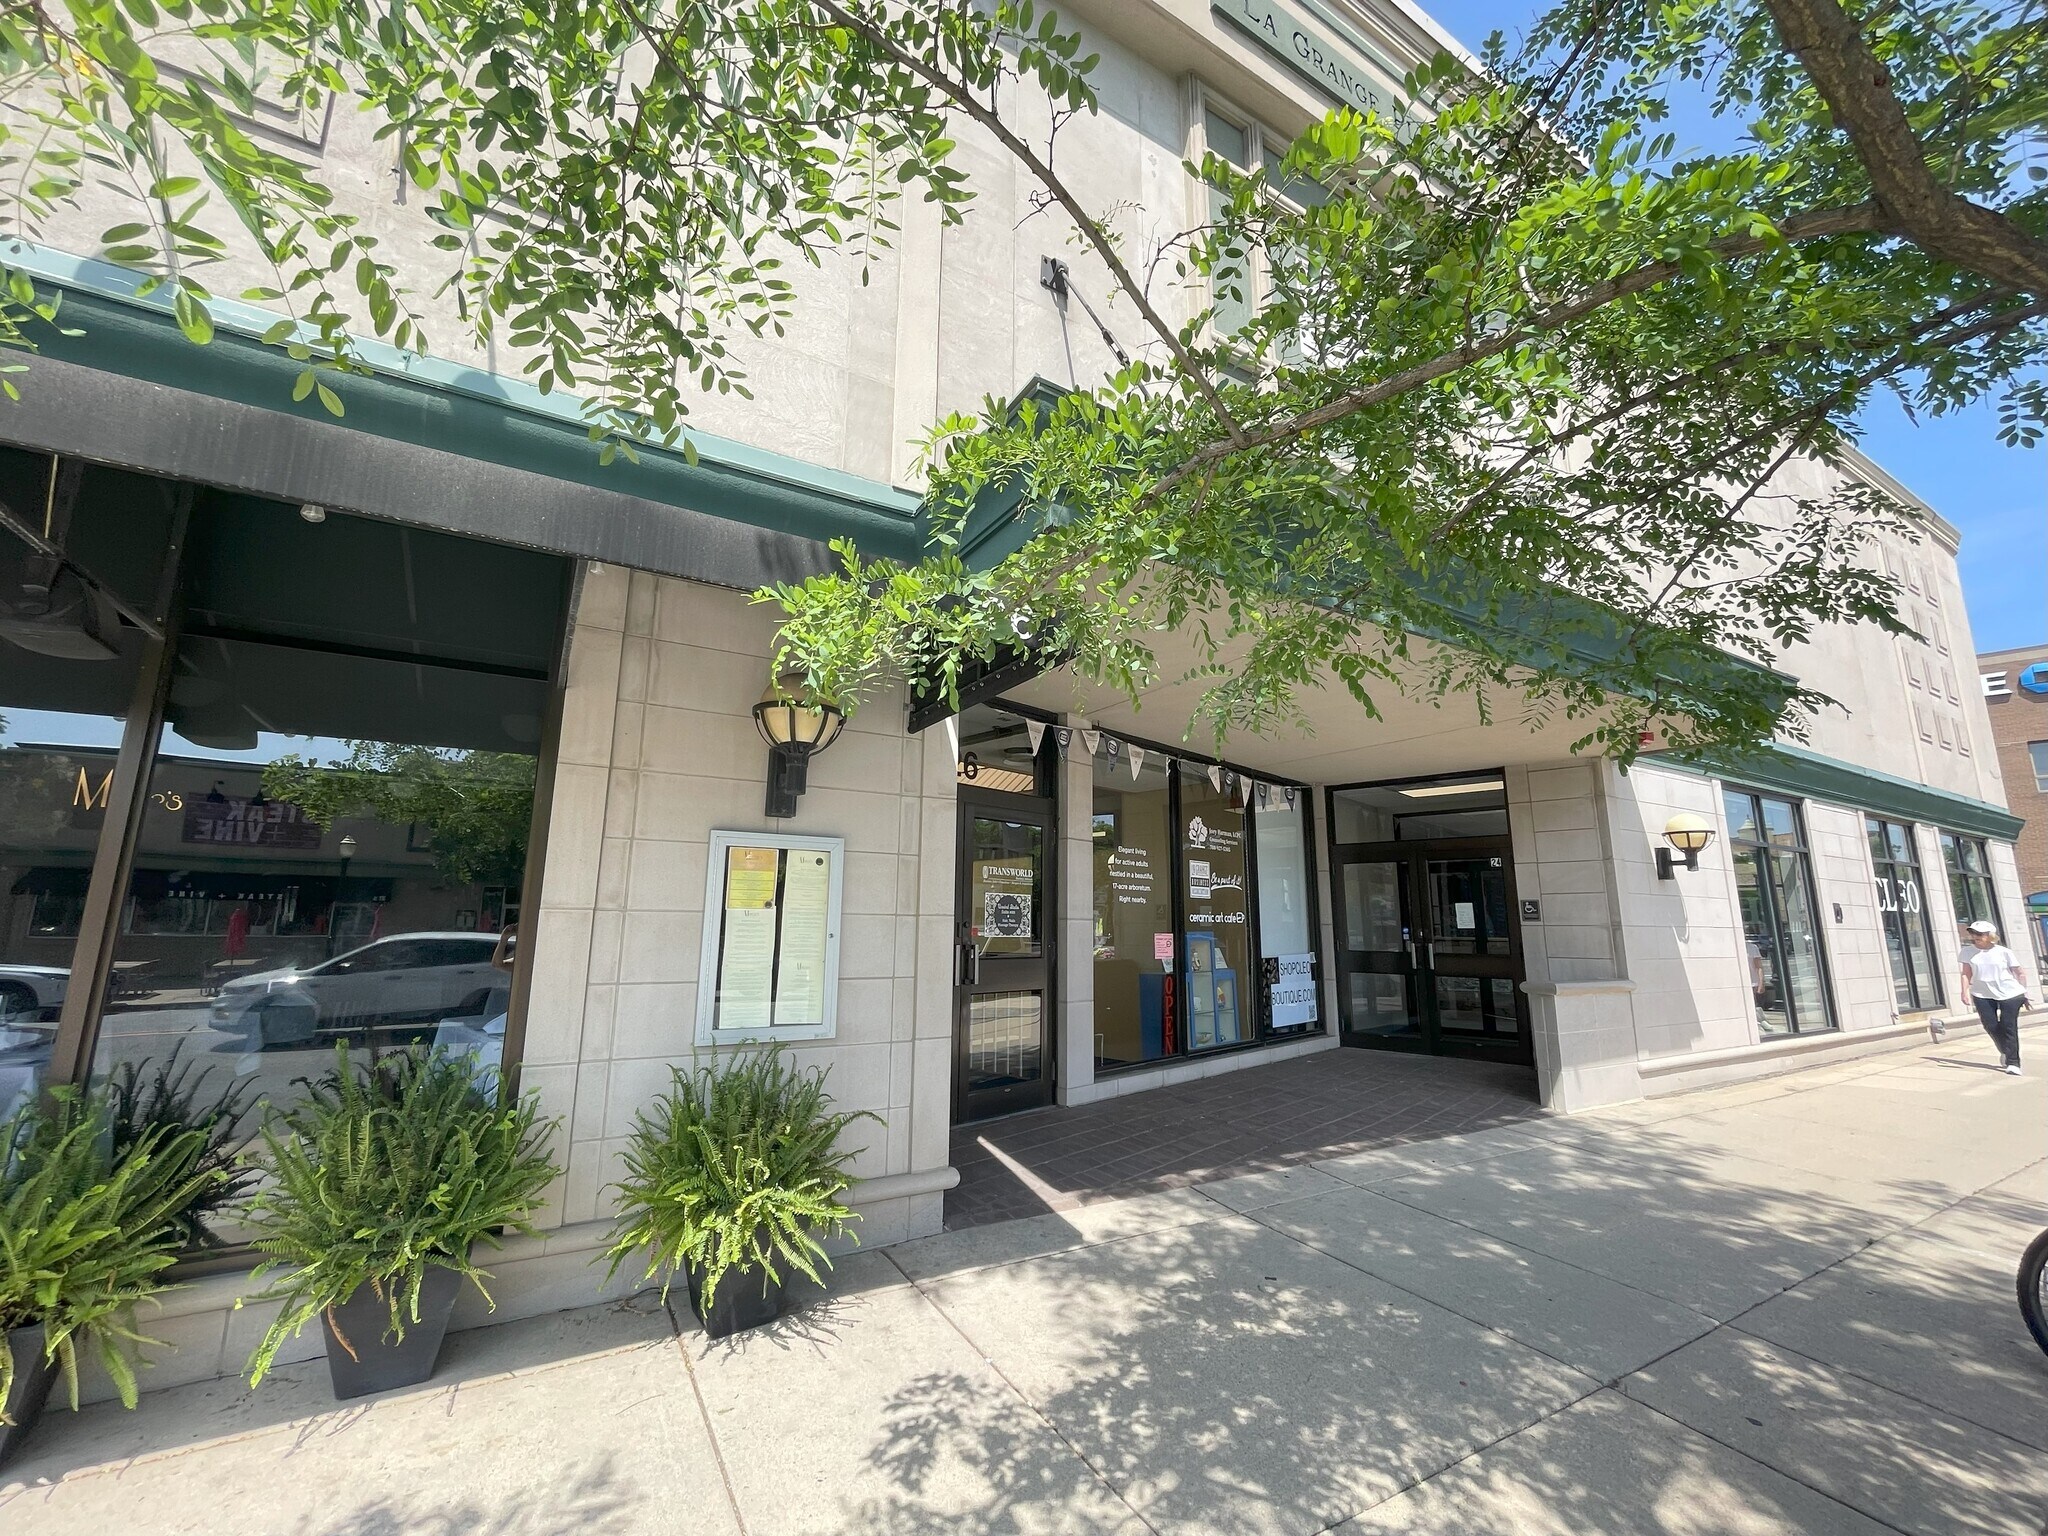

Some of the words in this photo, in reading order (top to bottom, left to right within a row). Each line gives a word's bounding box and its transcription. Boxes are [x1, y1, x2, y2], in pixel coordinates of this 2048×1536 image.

[1293, 31, 1381, 114] GRANGE
[957, 751, 978, 780] 6
[988, 865, 1034, 878] TRANSWORLD
[1189, 911, 1215, 923] ceramic
[1214, 911, 1224, 923] art
[1223, 912, 1236, 923] cafe
[1164, 976, 1174, 1057] OPEN
